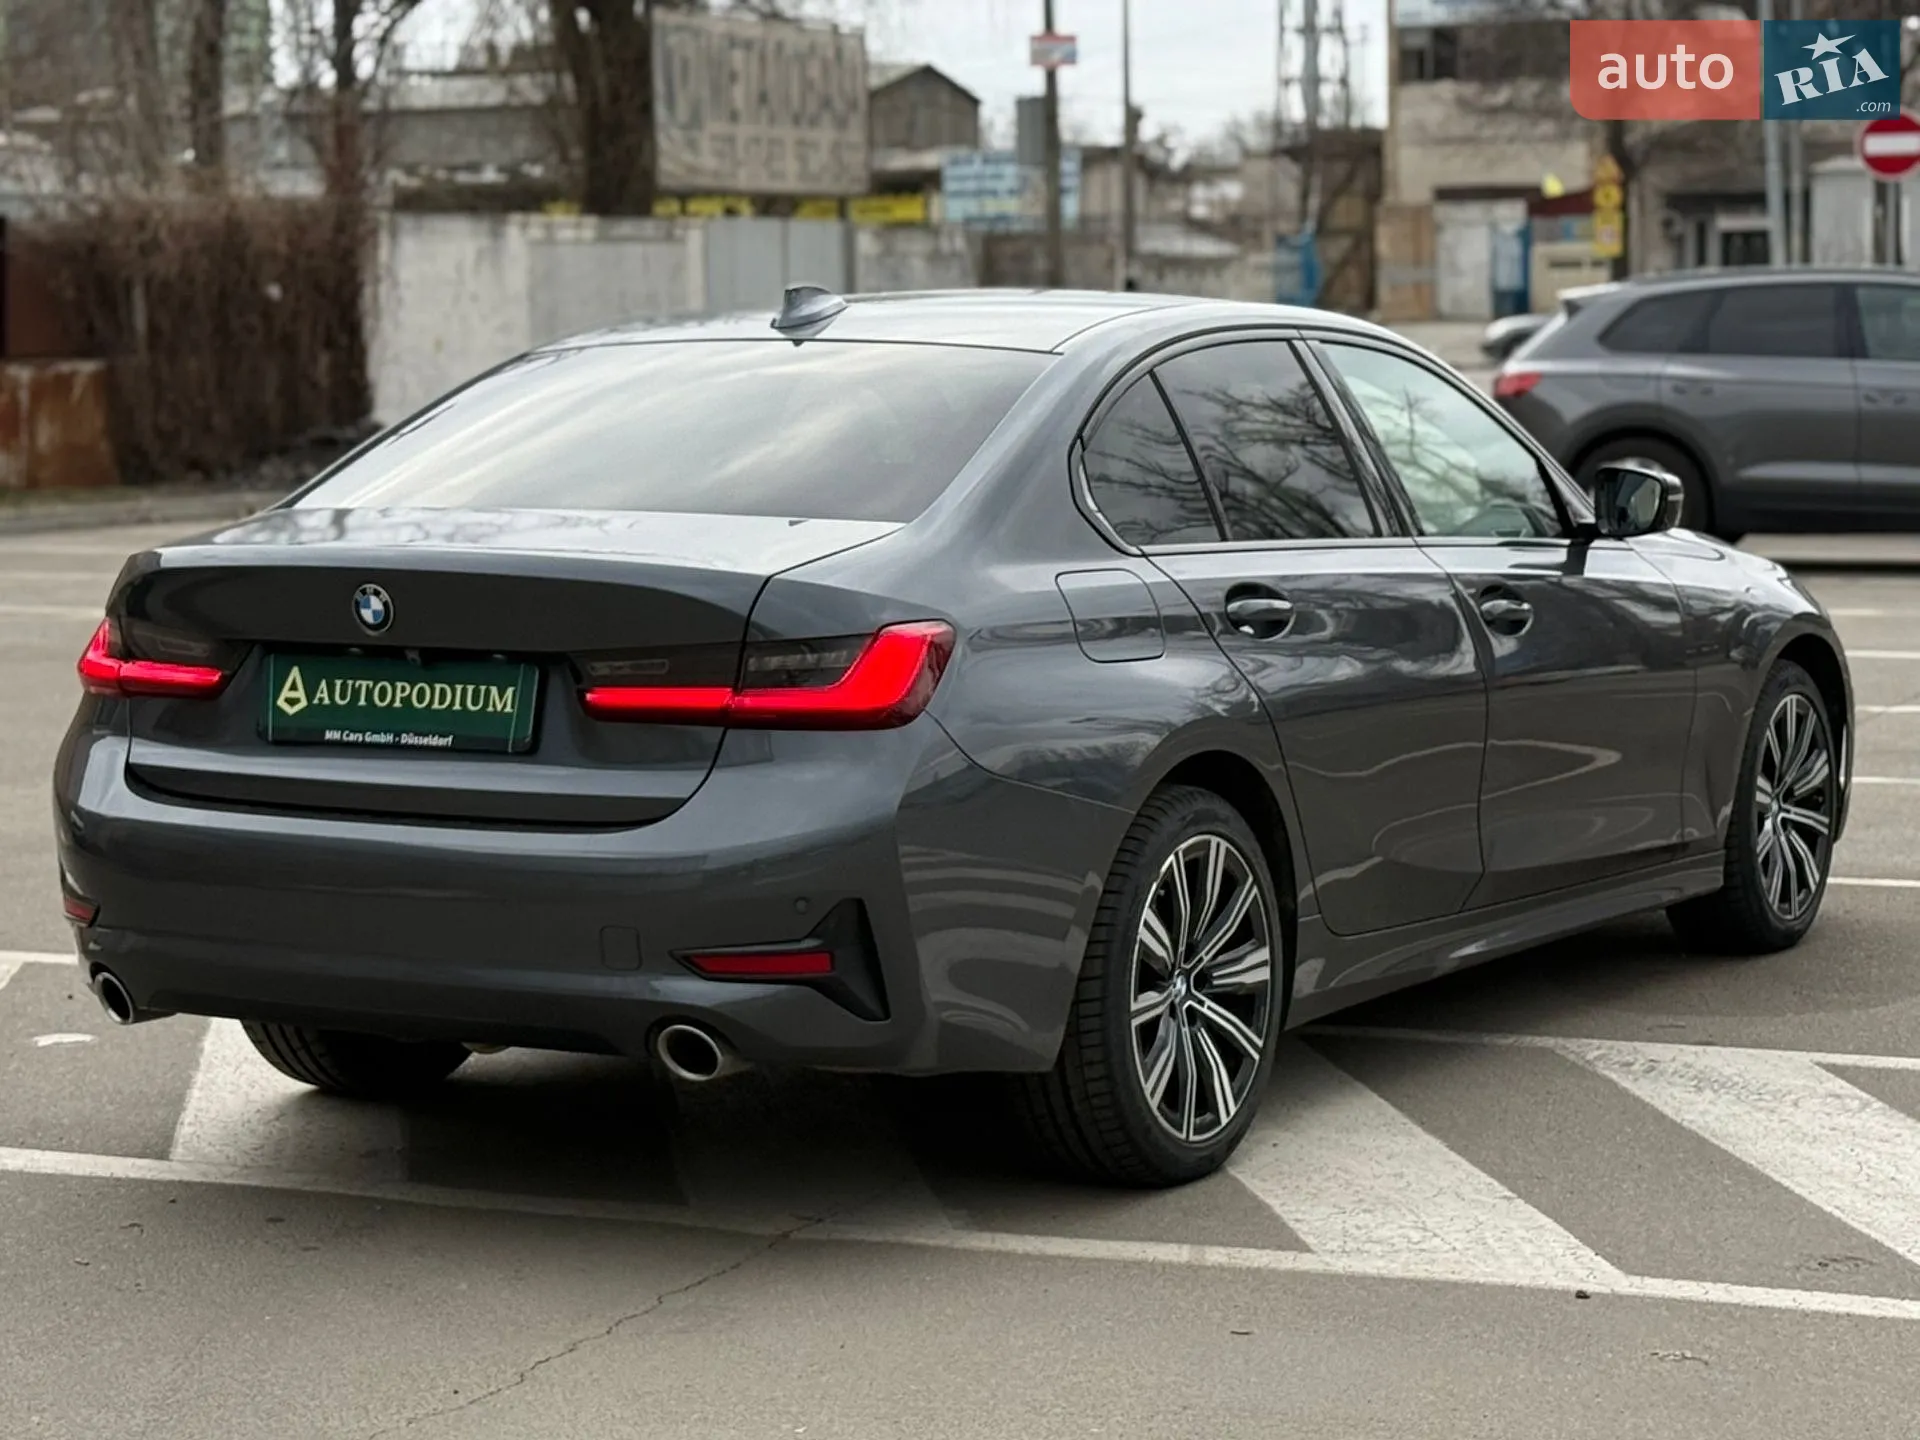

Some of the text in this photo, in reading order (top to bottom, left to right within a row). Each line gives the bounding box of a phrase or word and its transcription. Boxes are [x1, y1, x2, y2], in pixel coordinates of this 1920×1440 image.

[313, 678, 516, 713] AUTOPODIUM
[342, 730, 363, 742] Cars
[364, 731, 394, 744] GmbH
[400, 732, 454, 747] Düsseldorf
